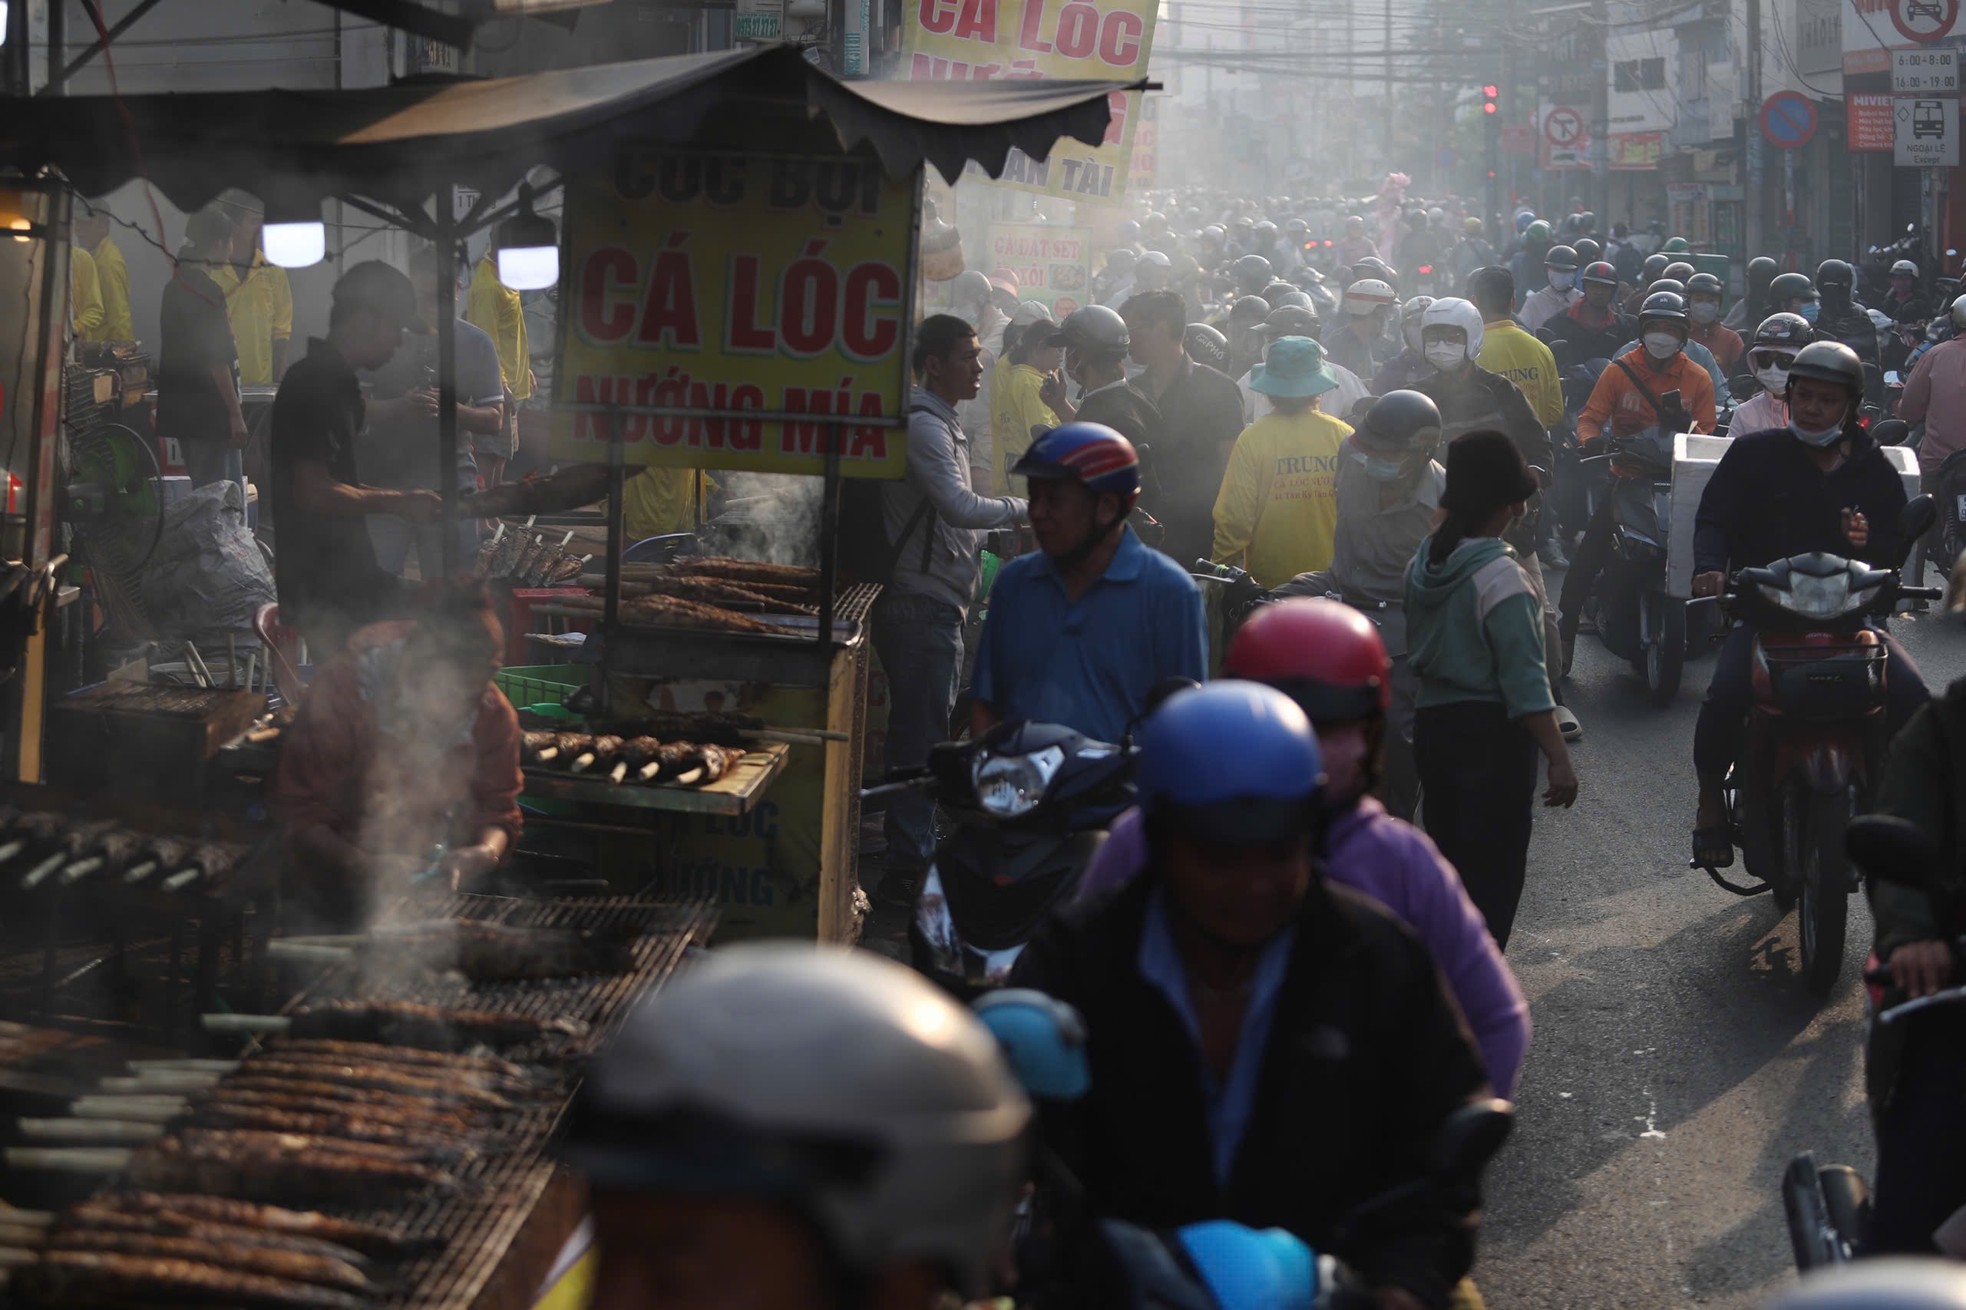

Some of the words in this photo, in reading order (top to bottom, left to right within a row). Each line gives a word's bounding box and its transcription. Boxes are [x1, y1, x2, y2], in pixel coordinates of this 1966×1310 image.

[1898, 54, 1920, 65] 6:00
[1928, 54, 1951, 65] 8:00
[1895, 77, 1920, 87] 16:00
[1929, 76, 1954, 87] 19:00
[1063, 158, 1113, 197] TÀI
[582, 231, 699, 346] CÁ
[731, 240, 900, 358] LÓC
[574, 366, 764, 451] NƯỚNG
[780, 376, 887, 459] MÍA
